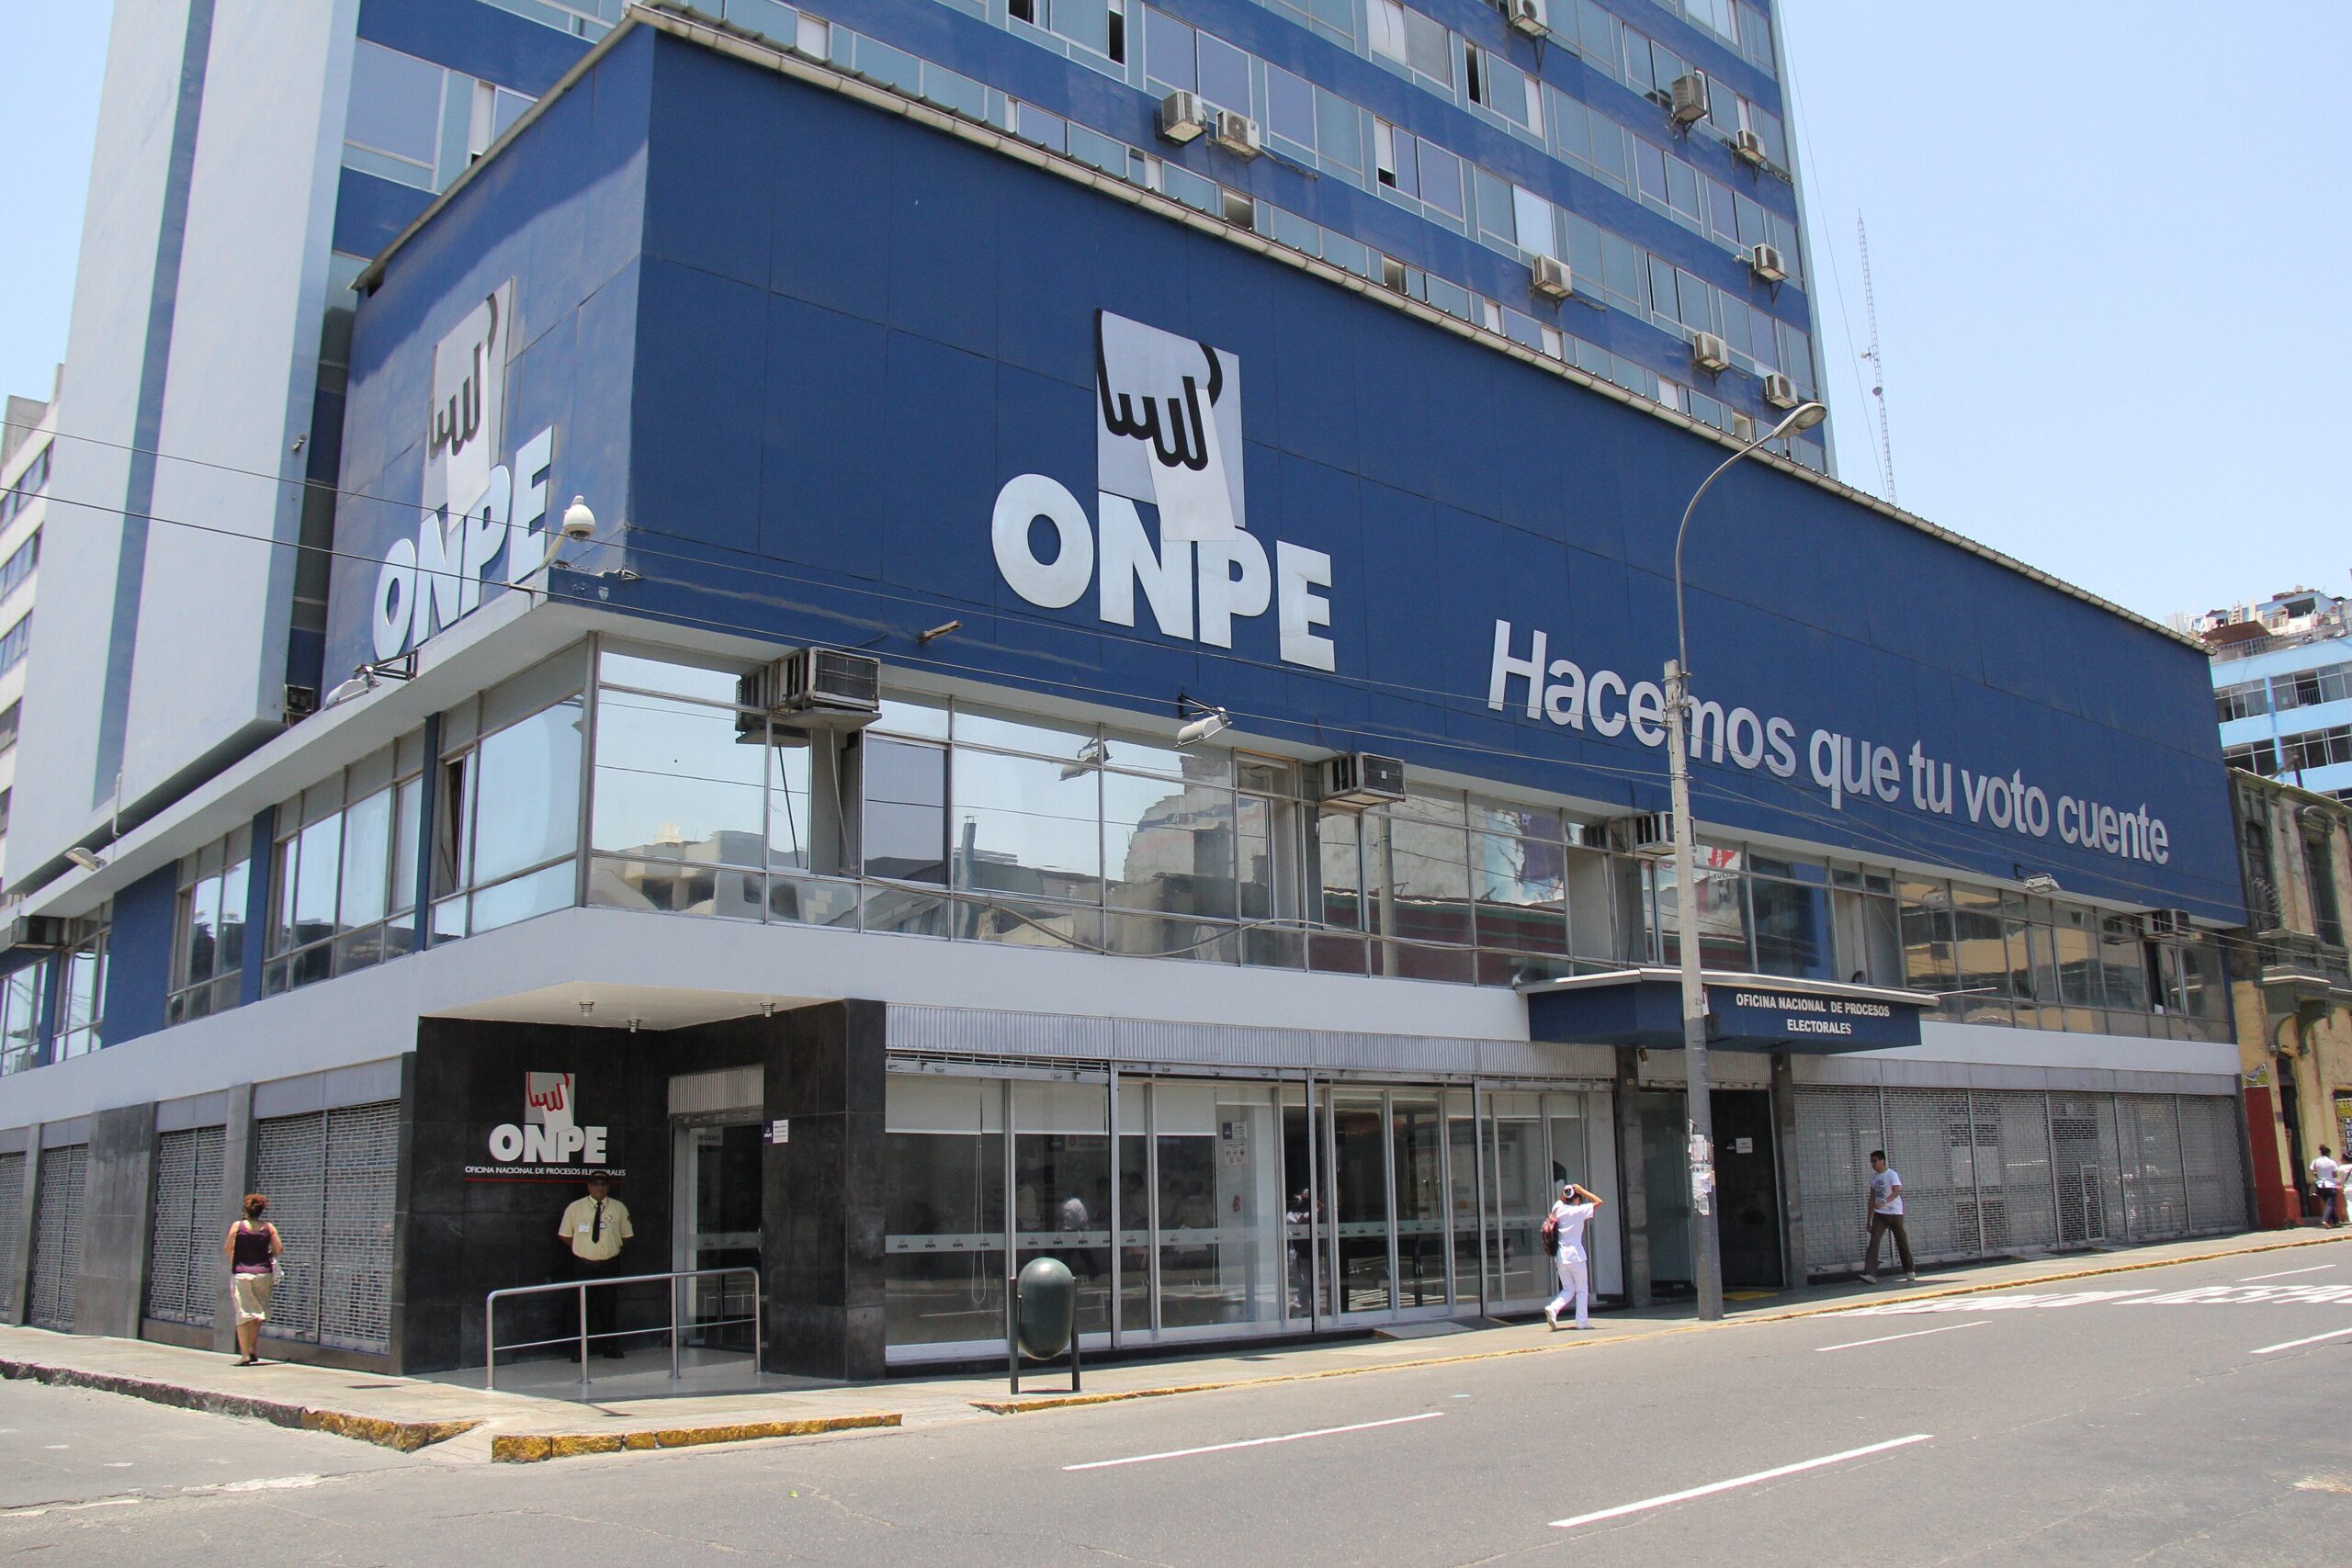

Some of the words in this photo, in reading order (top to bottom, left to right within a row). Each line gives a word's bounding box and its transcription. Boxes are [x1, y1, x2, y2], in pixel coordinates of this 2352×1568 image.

[373, 425, 554, 661] ONPE
[991, 473, 1336, 672] ONPE
[1488, 619, 1797, 778] Hacemos
[1809, 728, 1901, 810] que
[1908, 739, 1952, 815] tu
[1961, 768, 2050, 838] voto
[2057, 795, 2169, 865] cuente
[1736, 993, 1777, 1009] OFICINA
[1779, 997, 1826, 1012] NACIONAL
[1831, 1001, 1843, 1013] DE
[1845, 1002, 1890, 1017] PROCESOS
[1787, 1019, 1852, 1034] ELECTORALES
[489, 1123, 607, 1164] ONPE
